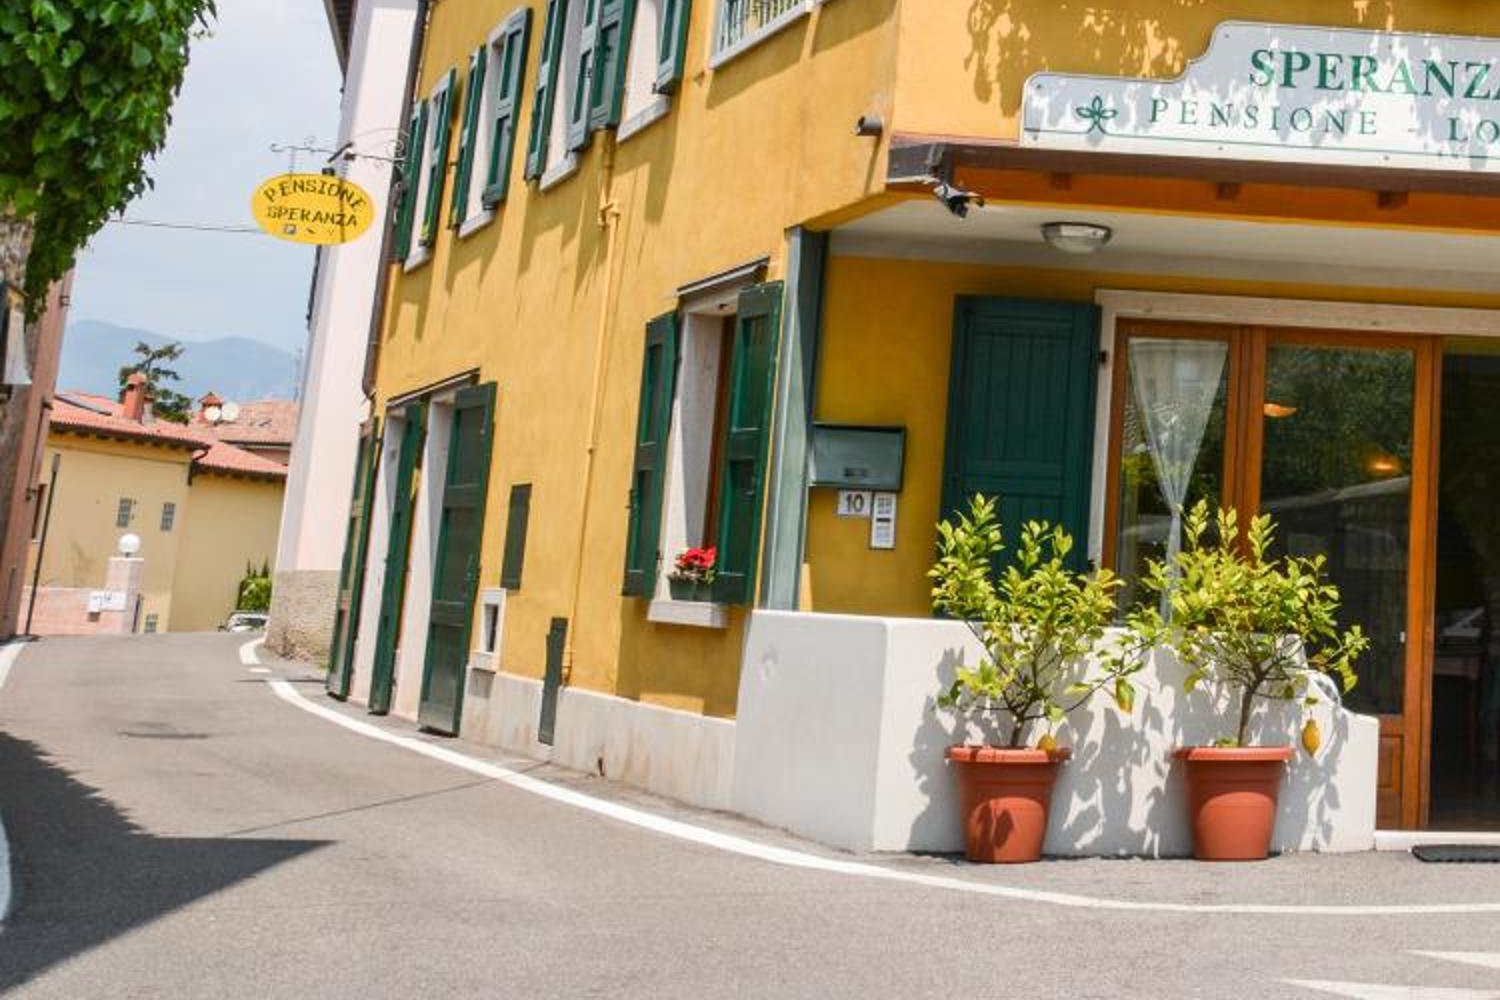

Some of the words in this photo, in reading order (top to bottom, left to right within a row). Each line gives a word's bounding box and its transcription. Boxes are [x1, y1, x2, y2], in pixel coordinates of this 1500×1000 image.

[1150, 100, 1377, 135] PENSIONE
[264, 179, 366, 211] PENSIONE
[267, 206, 357, 227] SPERANZA
[846, 494, 865, 512] 10
